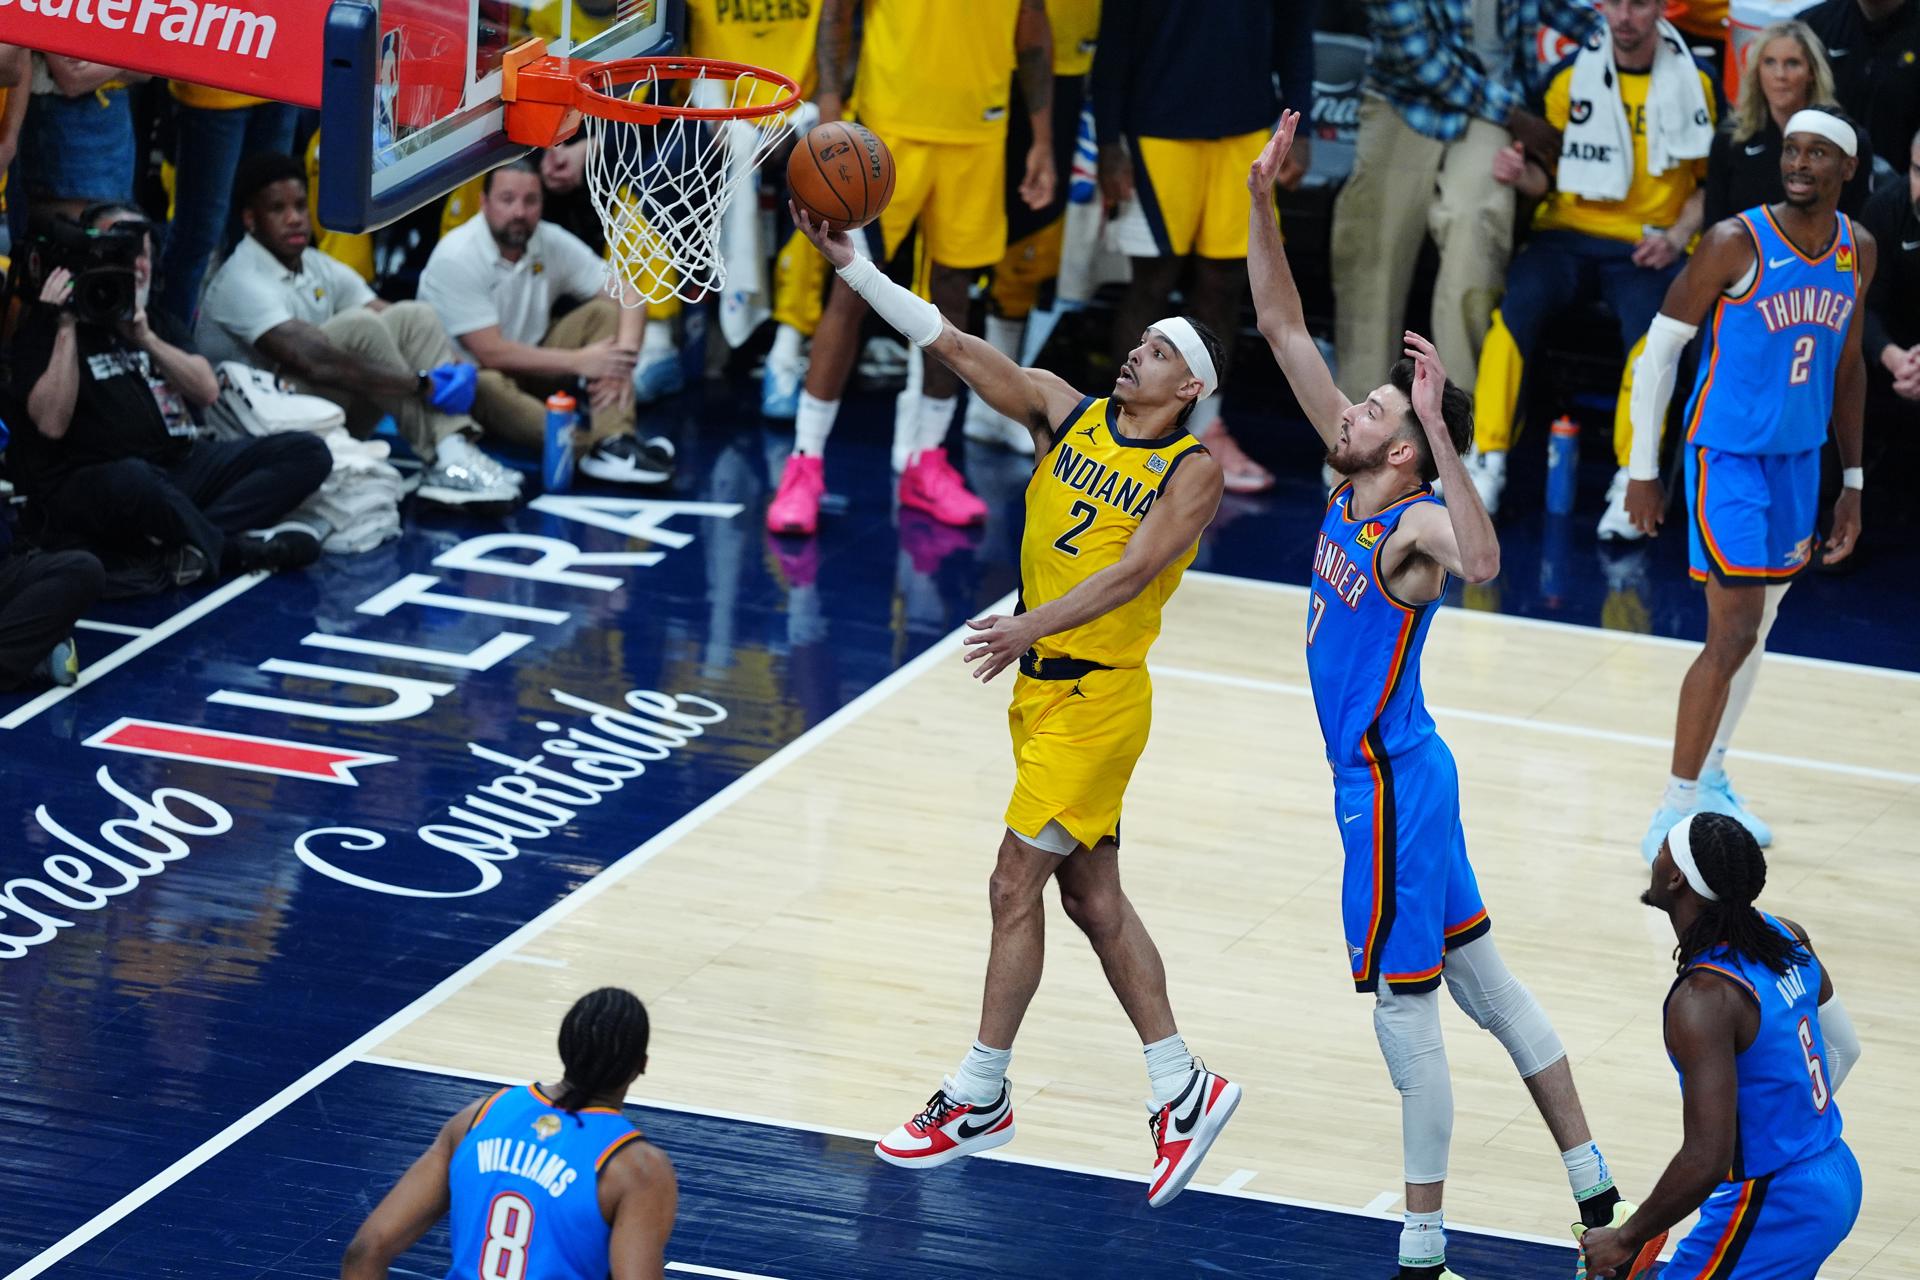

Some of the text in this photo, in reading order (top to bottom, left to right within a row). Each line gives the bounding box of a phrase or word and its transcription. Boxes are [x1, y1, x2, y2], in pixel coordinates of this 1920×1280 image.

[0, 0, 277, 59] ateFarm
[1755, 285, 1855, 334] THUNDER
[1788, 335, 1815, 387] 2
[1052, 442, 1158, 521] INDIANA
[1053, 499, 1098, 557] 2
[207, 495, 744, 720] ULTRA
[1307, 592, 1326, 646] 7
[295, 688, 727, 898] Courtside
[1797, 1015, 1830, 1115] 5
[477, 1137, 578, 1198] WILLIAMS
[479, 1190, 535, 1280] 8
